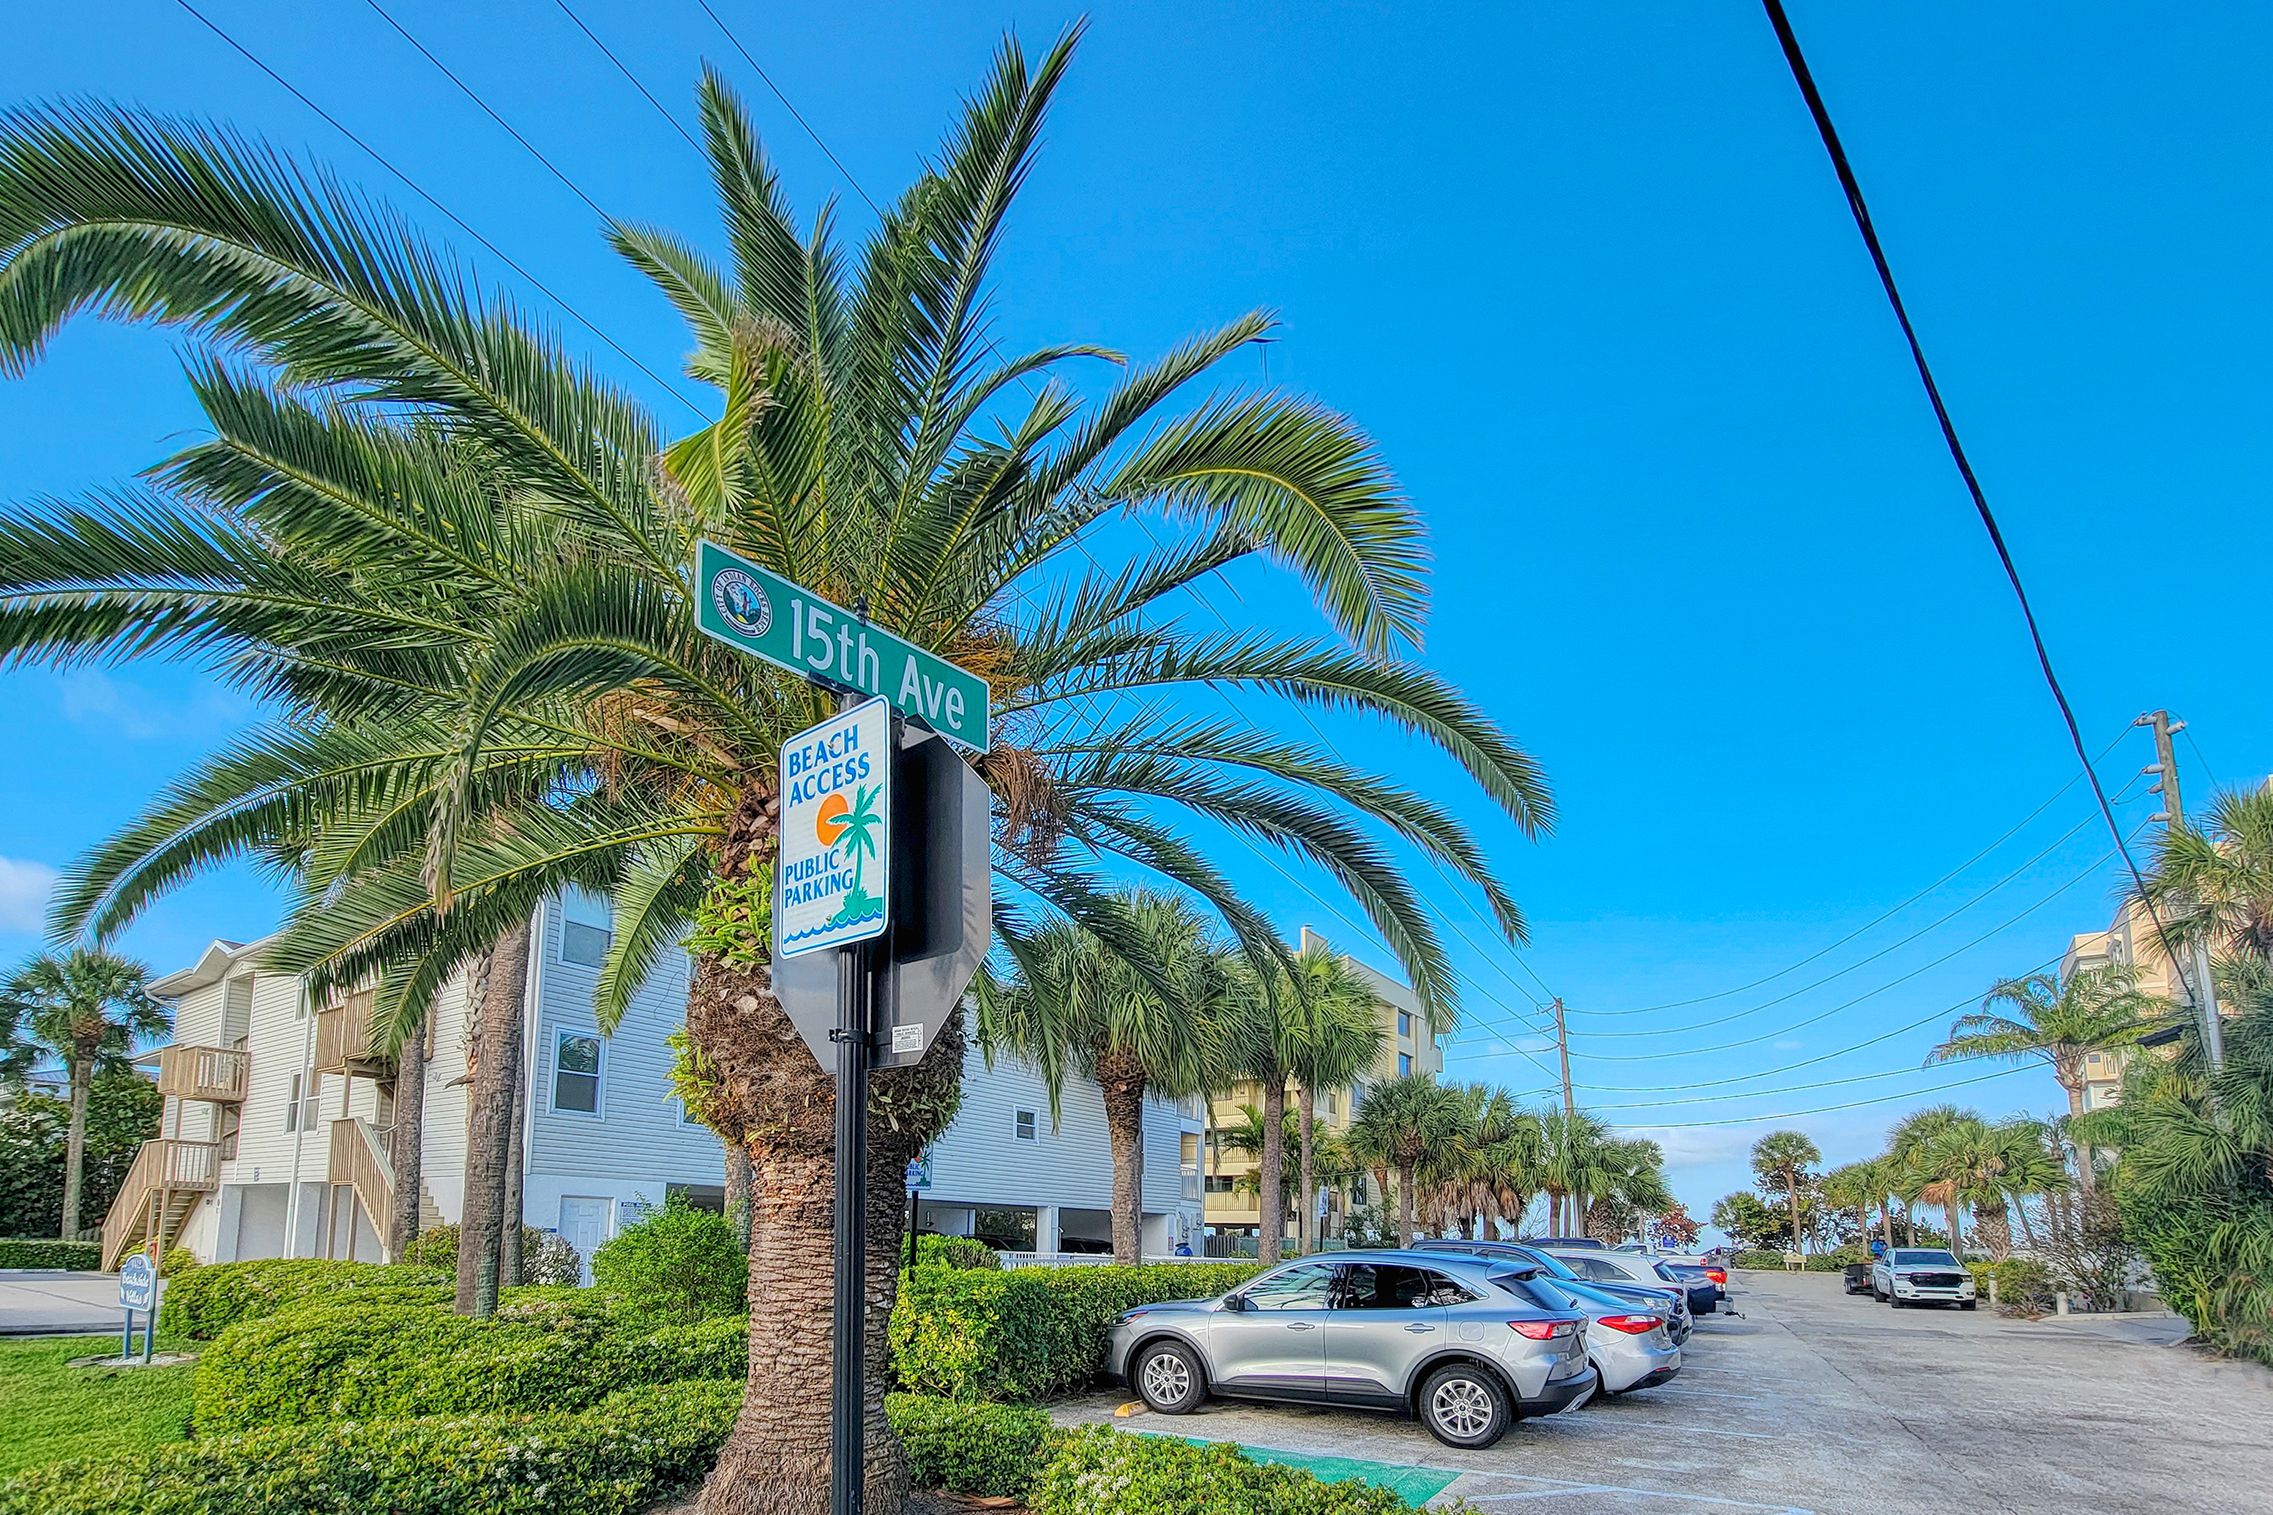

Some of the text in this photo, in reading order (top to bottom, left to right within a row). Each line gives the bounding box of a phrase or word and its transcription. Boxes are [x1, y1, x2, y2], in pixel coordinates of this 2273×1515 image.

[715, 580, 725, 592] OF
[720, 572, 747, 584] INDIAN
[749, 580, 767, 608] ROCKS
[715, 593, 728, 614] CITY
[790, 598, 966, 731] 15th Ave
[788, 723, 859, 778] BEACH
[788, 751, 871, 808] ACCESS
[785, 848, 840, 886] PUBLIC
[784, 868, 854, 909] PARKING
